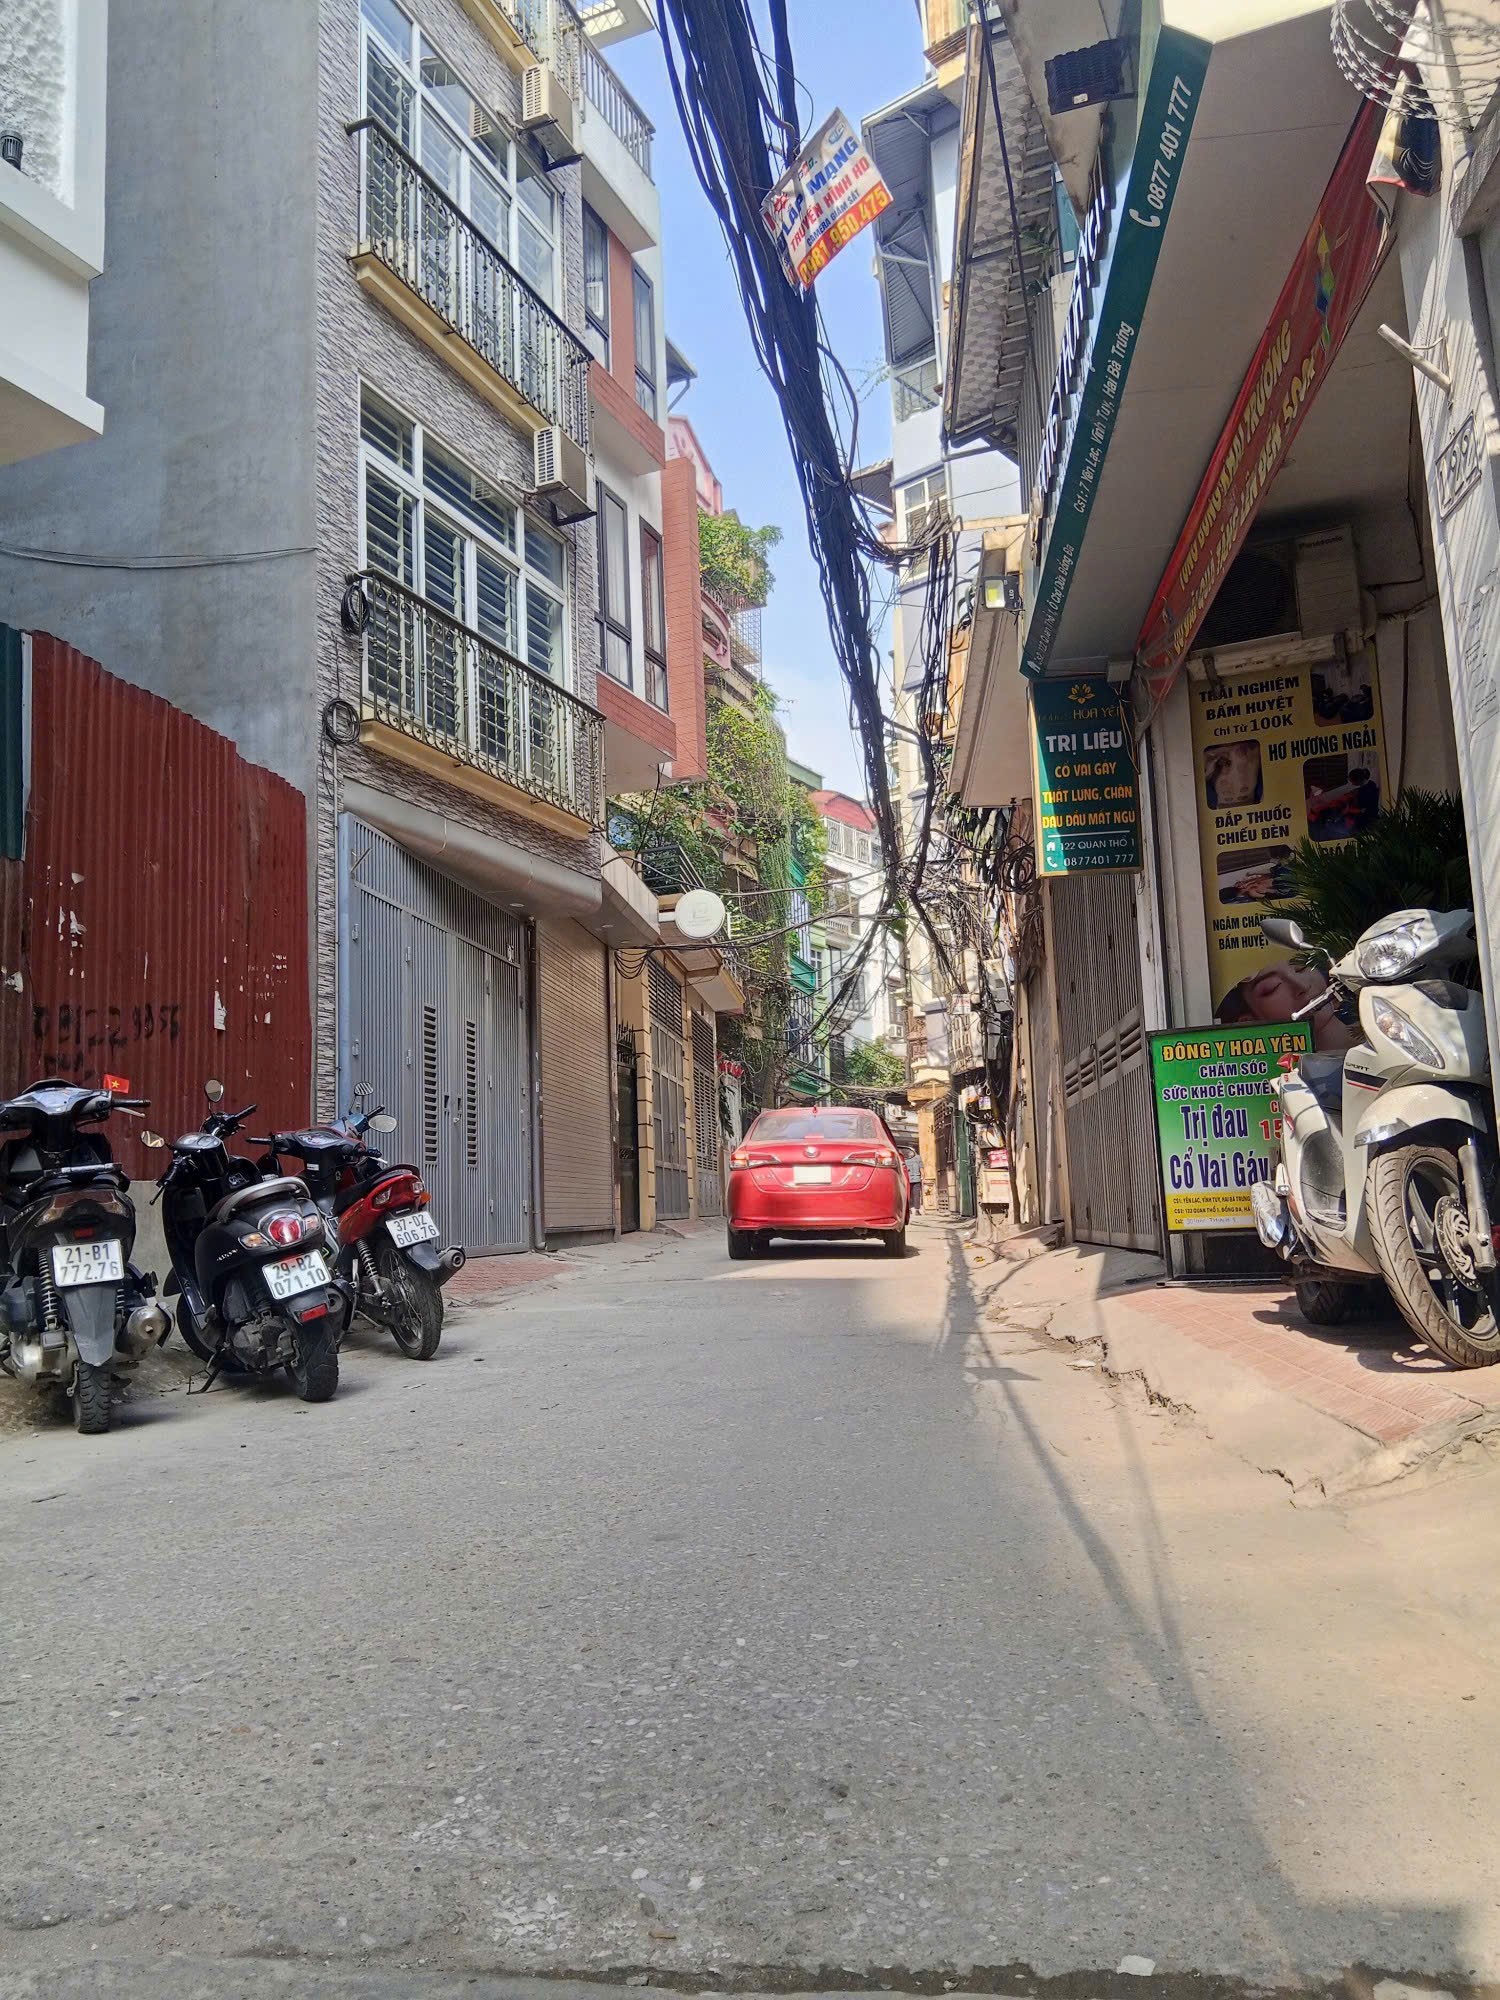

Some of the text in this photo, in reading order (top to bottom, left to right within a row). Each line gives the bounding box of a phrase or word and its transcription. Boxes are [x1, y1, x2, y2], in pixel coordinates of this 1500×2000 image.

[1146, 75, 1192, 211] 0877 401 777
[806, 136, 858, 195] MẠNG
[790, 203, 823, 252] TRUYỀN
[822, 176, 852, 208] HÌNH
[799, 189, 888, 284] 0981.950.475
[806, 217, 831, 246] CAMERA
[1111, 320, 1134, 359] Trưng
[1107, 359, 1123, 379] Bà
[1102, 375, 1118, 399] Hai
[1081, 462, 1095, 484] Yên
[1238, 675, 1299, 698] NGHIỆM
[1206, 696, 1294, 720] BẤM HUYỆT
[1250, 713, 1294, 732] 100K
[1045, 728, 1123, 756] TRỊ LIỆU
[1268, 724, 1377, 761] HƠ HƯƠNG NGẢI
[1054, 760, 1117, 778] CỔ VAI GÁY
[1104, 784, 1133, 799] CHÂN
[1042, 814, 1063, 829] ĐAU
[1088, 809, 1110, 825] MẤT
[1215, 804, 1292, 829] ĐẮP THUỐC
[1077, 840, 1107, 850] QUAN
[1109, 836, 1128, 848] THỔ
[1216, 823, 1290, 846] CHIẾU ĐÈN
[1063, 853, 1134, 867] 0877401 777
[1212, 915, 1241, 931] NGÂM
[1218, 933, 1239, 951] BẤM
[1162, 1033, 1307, 1062] ĐÔNG Y HOA YÊN
[1199, 1059, 1268, 1078] CHĂM SÓC
[1162, 1083, 1188, 1101] SỨC
[1180, 1103, 1249, 1147] Trị đau
[1169, 1146, 1194, 1189] Cổ
[1197, 1152, 1228, 1188] Vai
[396, 1225, 437, 1246] 606.76
[64, 1243, 111, 1265] 21-B1
[60, 1262, 119, 1283] 772.76
[272, 1254, 315, 1280] 29-B2
[274, 1267, 326, 1296] 071.10
